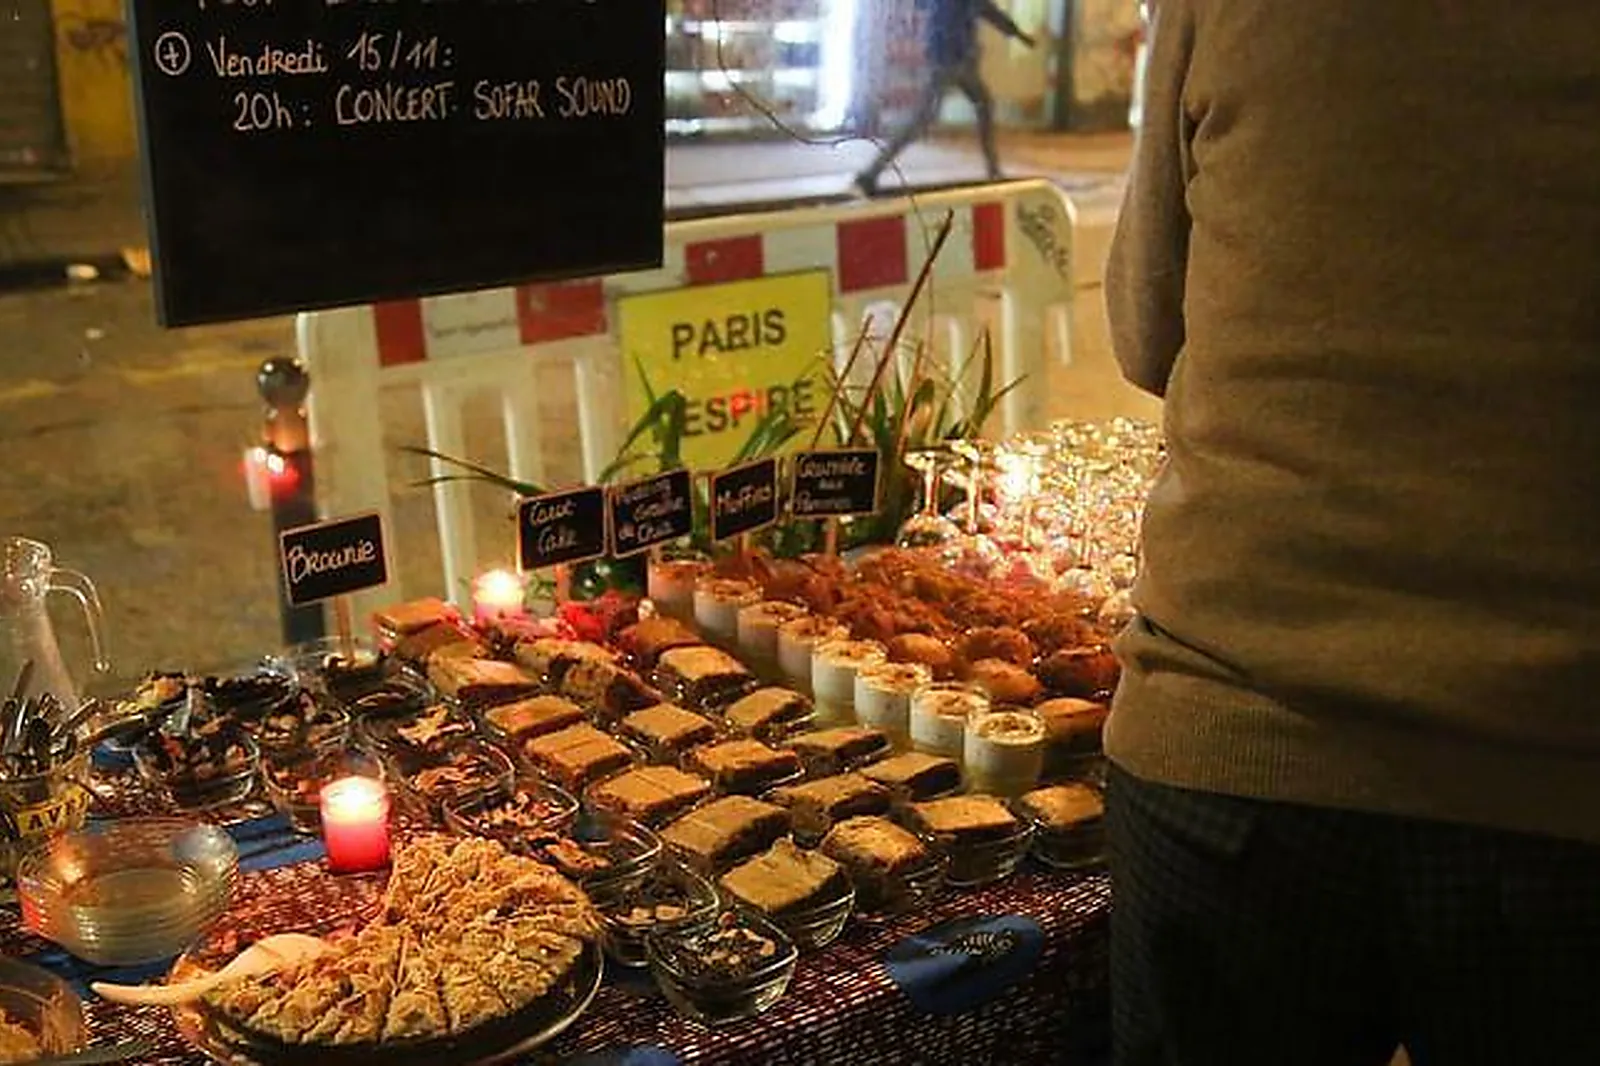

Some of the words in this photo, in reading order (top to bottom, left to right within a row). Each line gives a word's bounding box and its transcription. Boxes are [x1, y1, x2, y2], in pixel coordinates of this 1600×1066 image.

[206, 36, 328, 77] Vendredi
[475, 79, 544, 120] SOFAR
[556, 76, 631, 118] SOUND
[672, 309, 785, 359] PARIS
[680, 379, 814, 437] ESPIRE
[288, 540, 376, 584] Brownie
